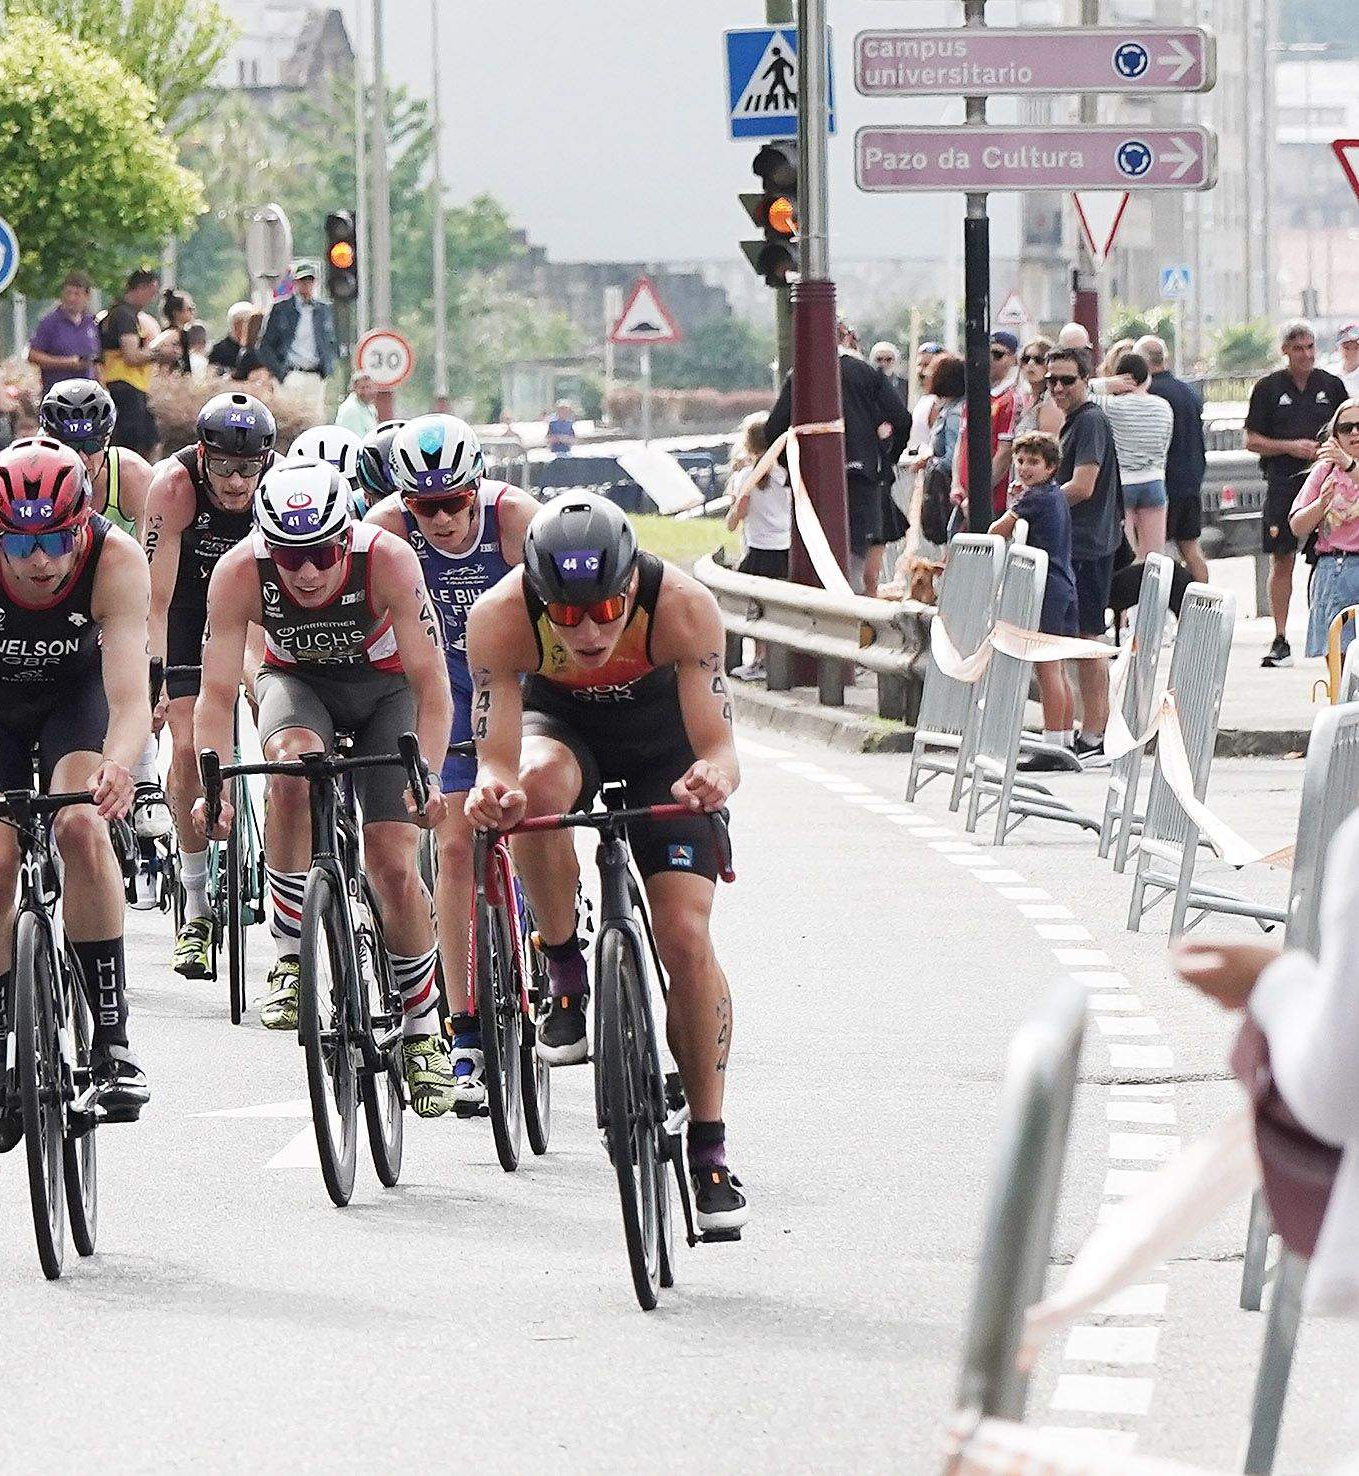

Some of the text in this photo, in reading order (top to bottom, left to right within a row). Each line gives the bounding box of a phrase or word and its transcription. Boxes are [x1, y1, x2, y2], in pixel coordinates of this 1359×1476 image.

[864, 40, 967, 61] campus
[864, 62, 1033, 85] universitario
[865, 146, 1085, 170] Pazo da Cultura
[370, 350, 401, 370] 30
[230, 413, 241, 423] 24
[69, 423, 79, 432] 17
[425, 475, 433, 487] 6
[19, 506, 33, 518] 14
[287, 515, 300, 527] 41
[562, 558, 578, 571] 44
[429, 588, 484, 604] LE BIH
[279, 630, 366, 650] FUCHS
[96, 956, 120, 1026] HUUB
